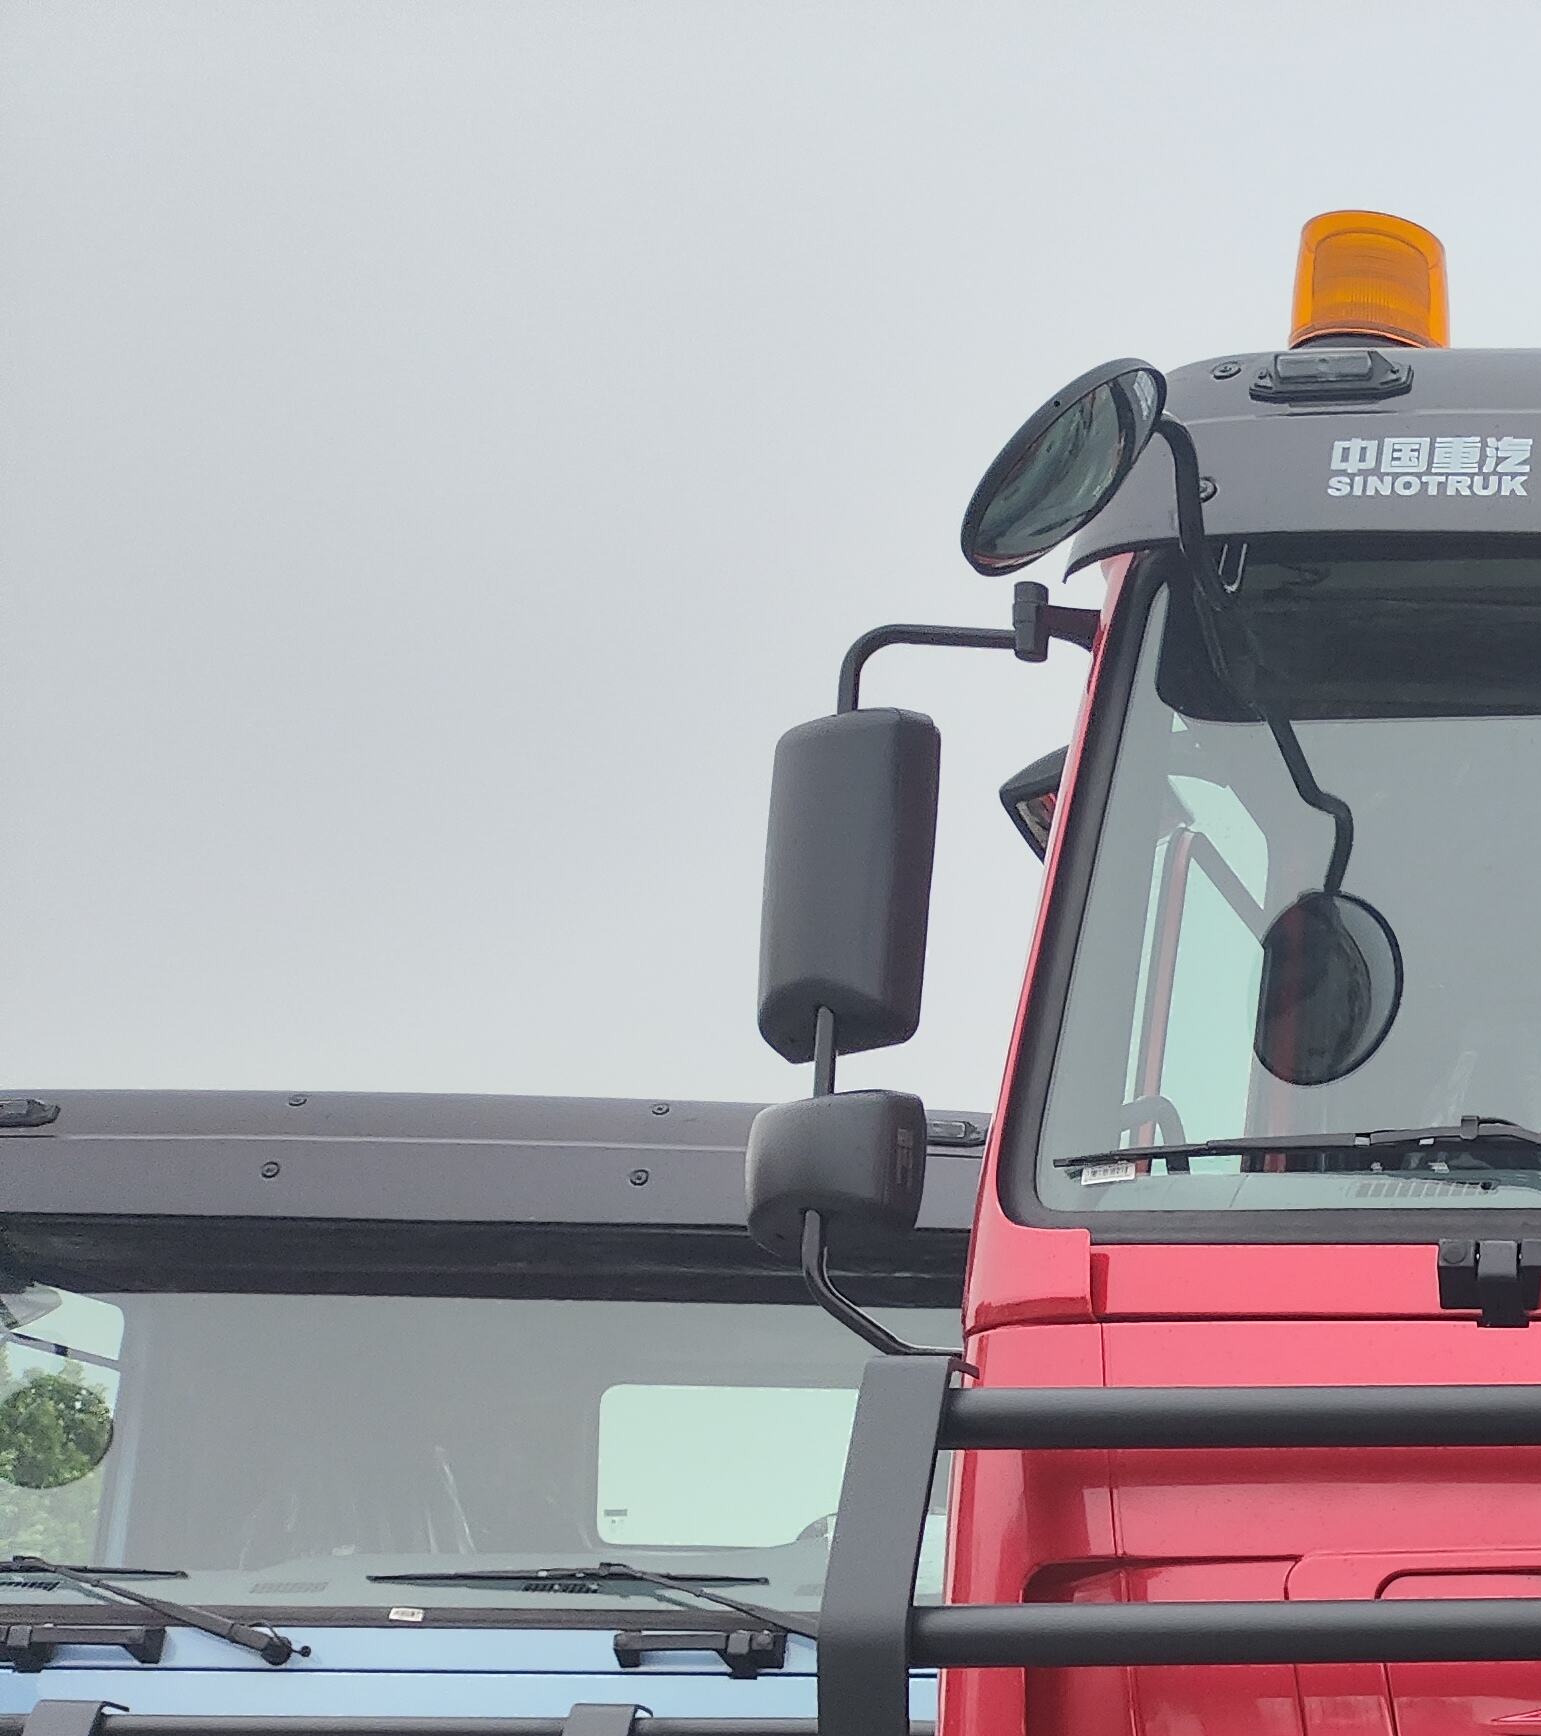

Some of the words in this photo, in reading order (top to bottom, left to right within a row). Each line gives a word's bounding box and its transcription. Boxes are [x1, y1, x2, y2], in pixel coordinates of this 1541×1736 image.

[1330, 436, 1533, 473] 中国重汽
[1327, 475, 1528, 496] SINOTRUK
